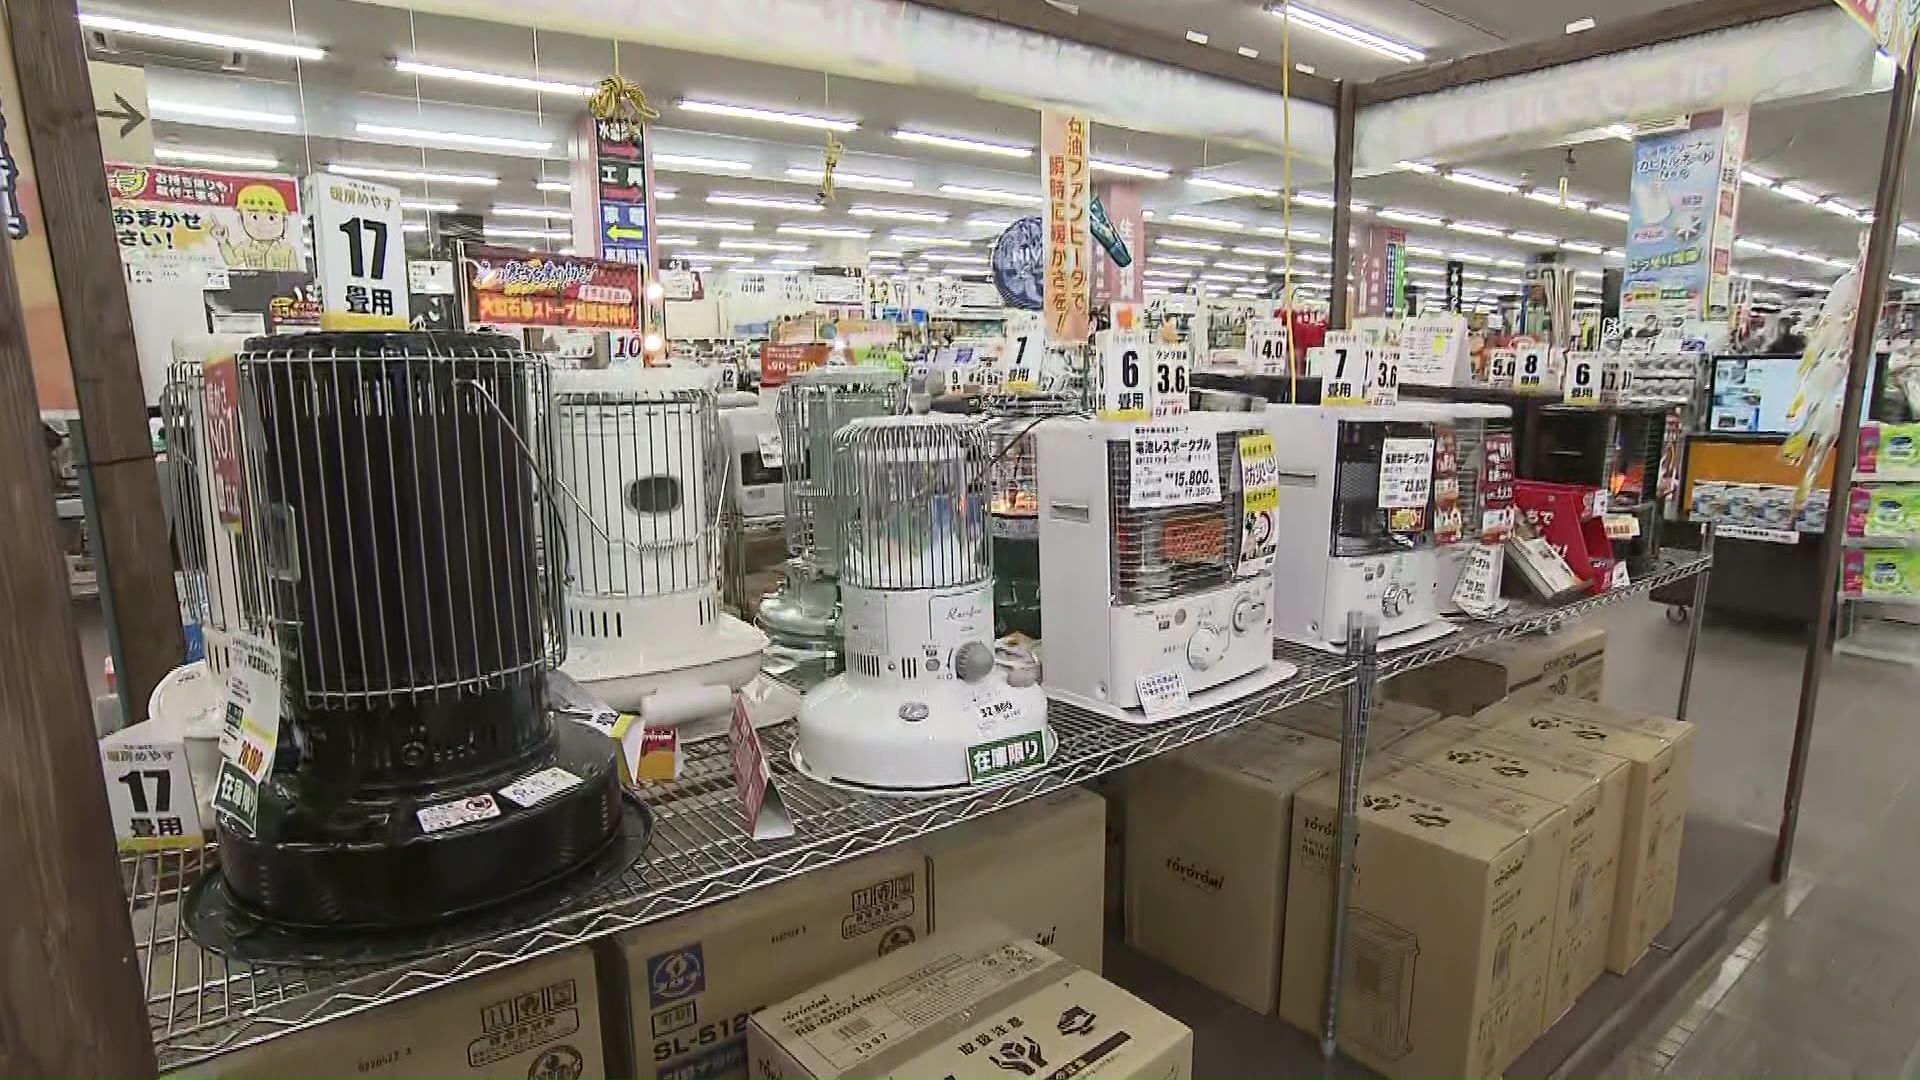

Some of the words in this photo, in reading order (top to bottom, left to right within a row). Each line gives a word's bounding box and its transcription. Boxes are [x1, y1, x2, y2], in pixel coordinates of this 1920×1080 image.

[113, 208, 202, 231] おまかせ
[339, 217, 388, 280] 17
[345, 285, 394, 317] 畳用
[1262, 339, 1284, 359] 4.0
[1122, 350, 1139, 388] 6
[1157, 363, 1186, 394] 3.6
[1335, 349, 1348, 380] 7
[1377, 362, 1398, 388] 3.6
[1524, 354, 1538, 375] 8
[1575, 363, 1591, 386] 6
[1118, 392, 1144, 410] 畳用
[118, 769, 172, 813] 17
